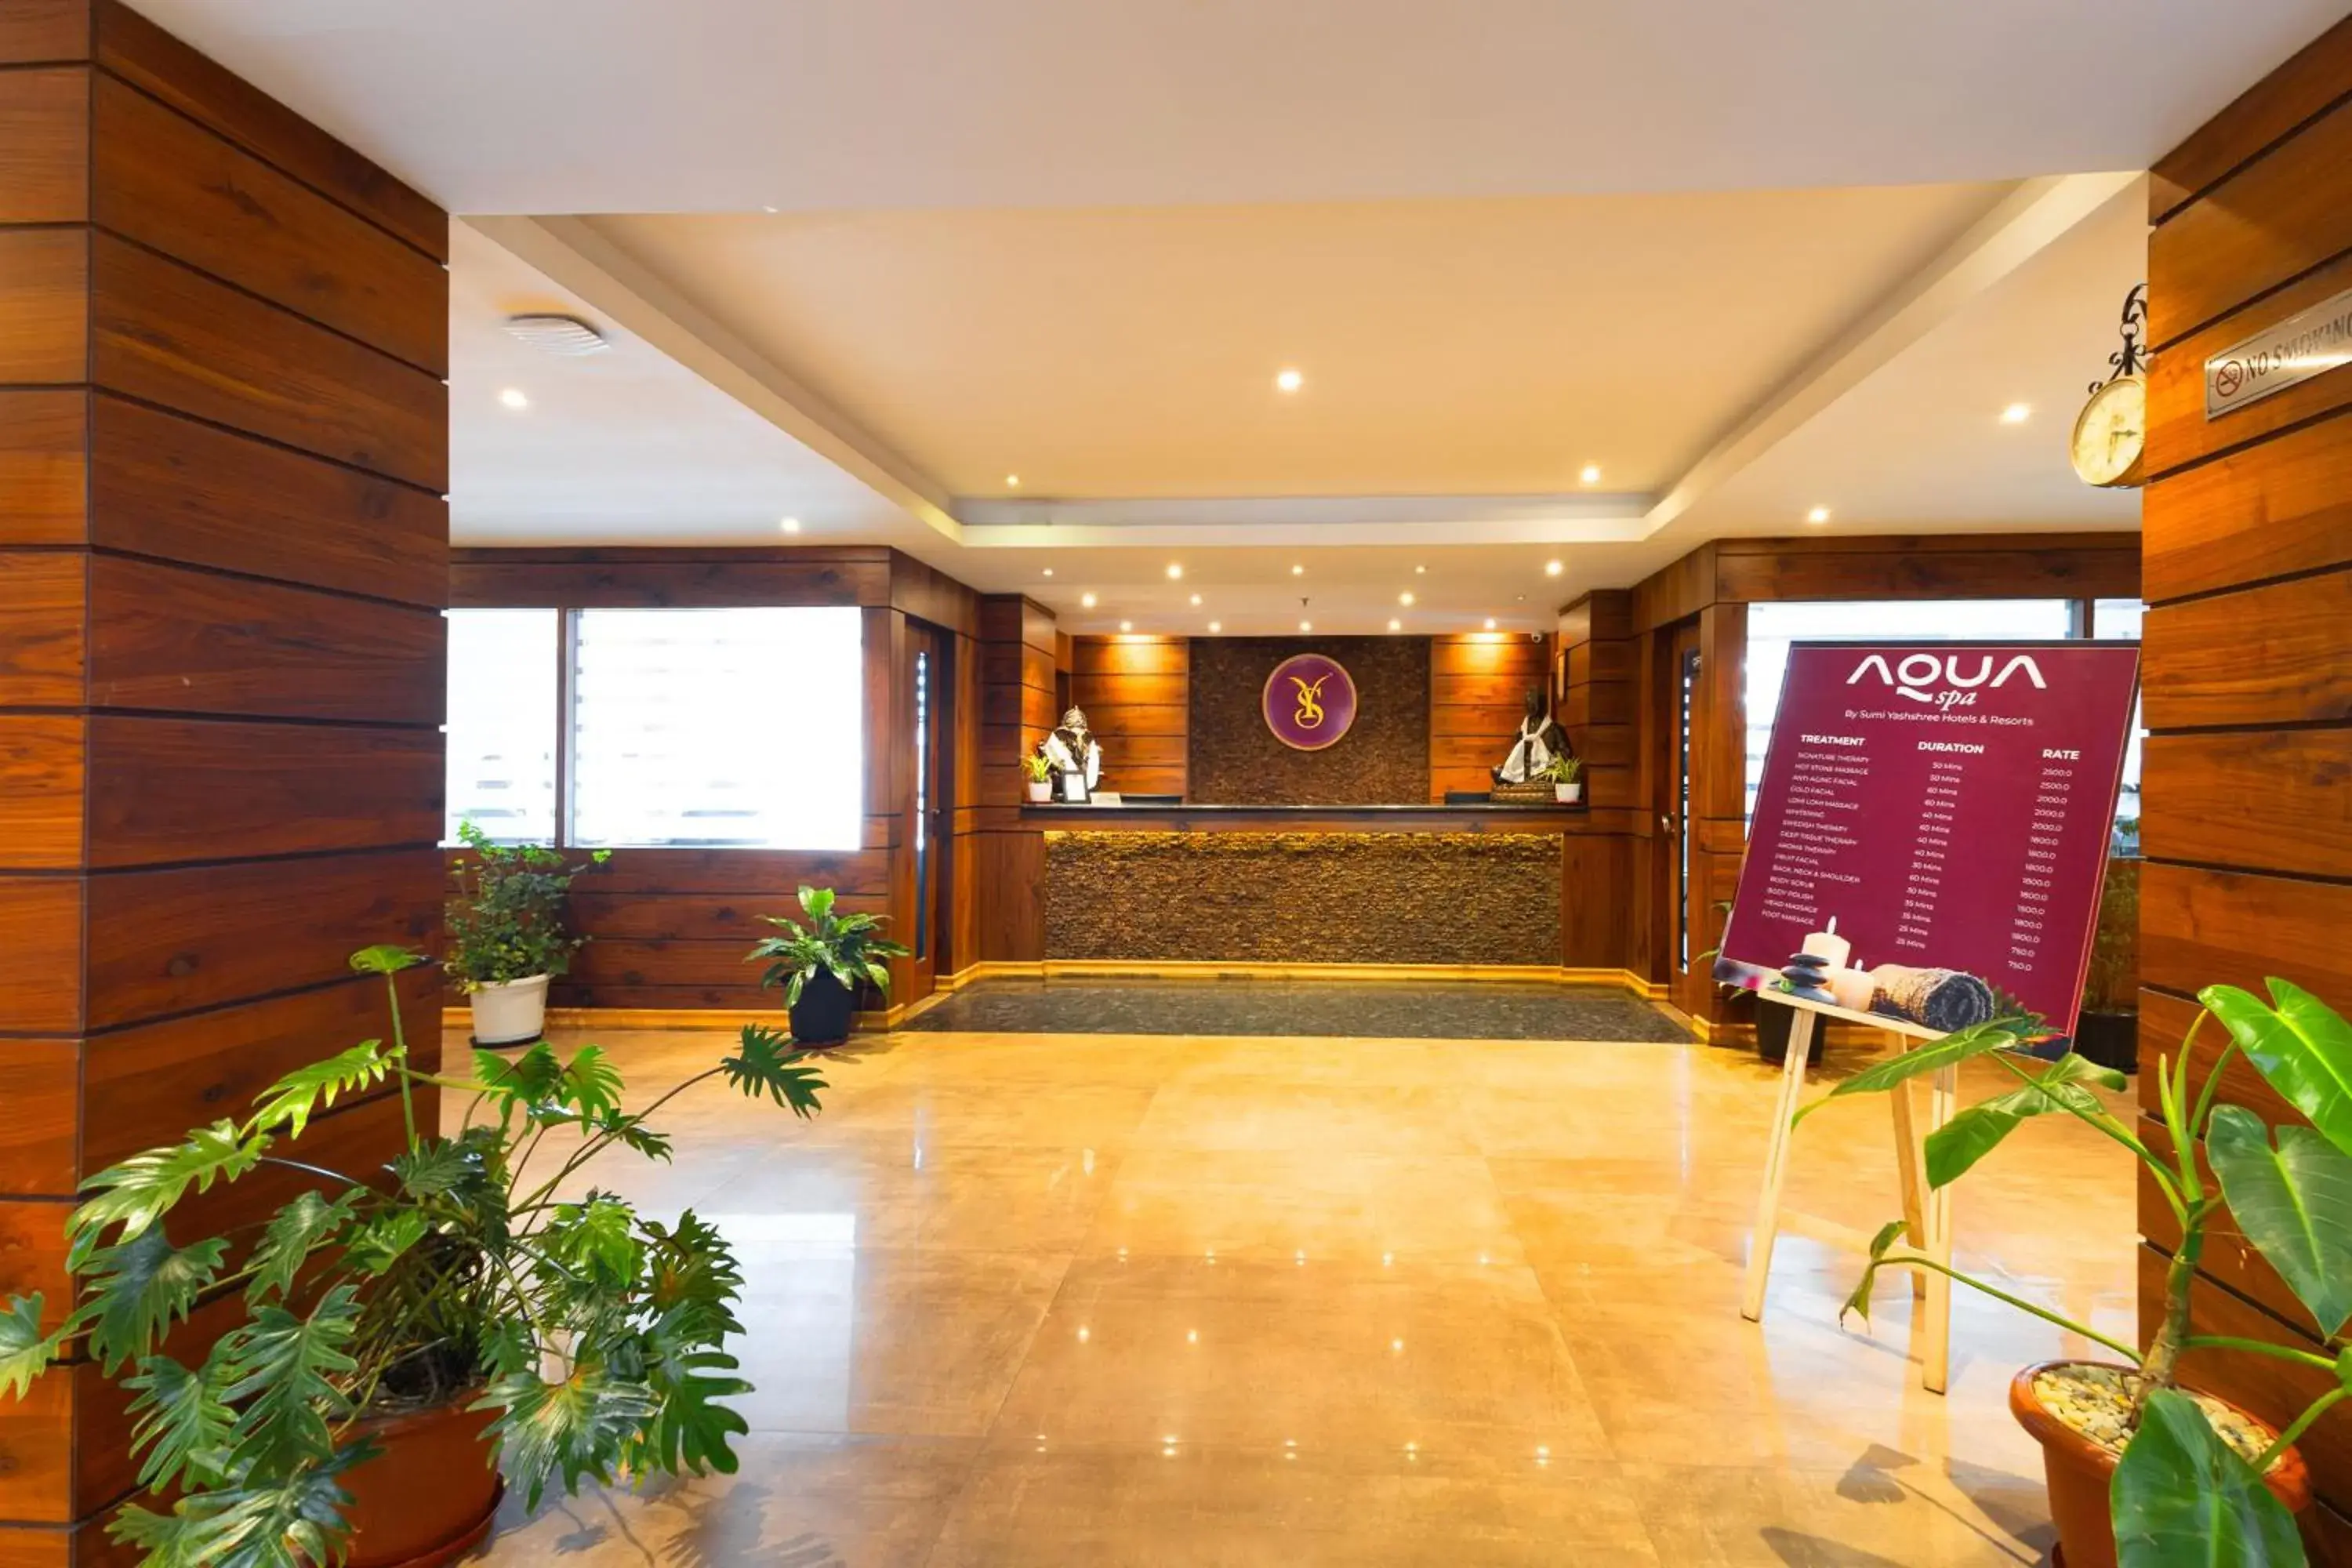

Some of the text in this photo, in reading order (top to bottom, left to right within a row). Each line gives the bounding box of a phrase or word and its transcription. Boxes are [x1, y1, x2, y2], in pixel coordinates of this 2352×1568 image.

[2246, 351, 2268, 382] NO
[1846, 654, 2048, 702] AQUA
[1934, 689, 1978, 712] spa
[1845, 709, 2034, 726] By Sumi Yashshree Hotels & Resorts
[1800, 734, 1866, 746] TREATMENT
[1917, 741, 1984, 753] DURATION
[2042, 749, 2080, 760] RATE
